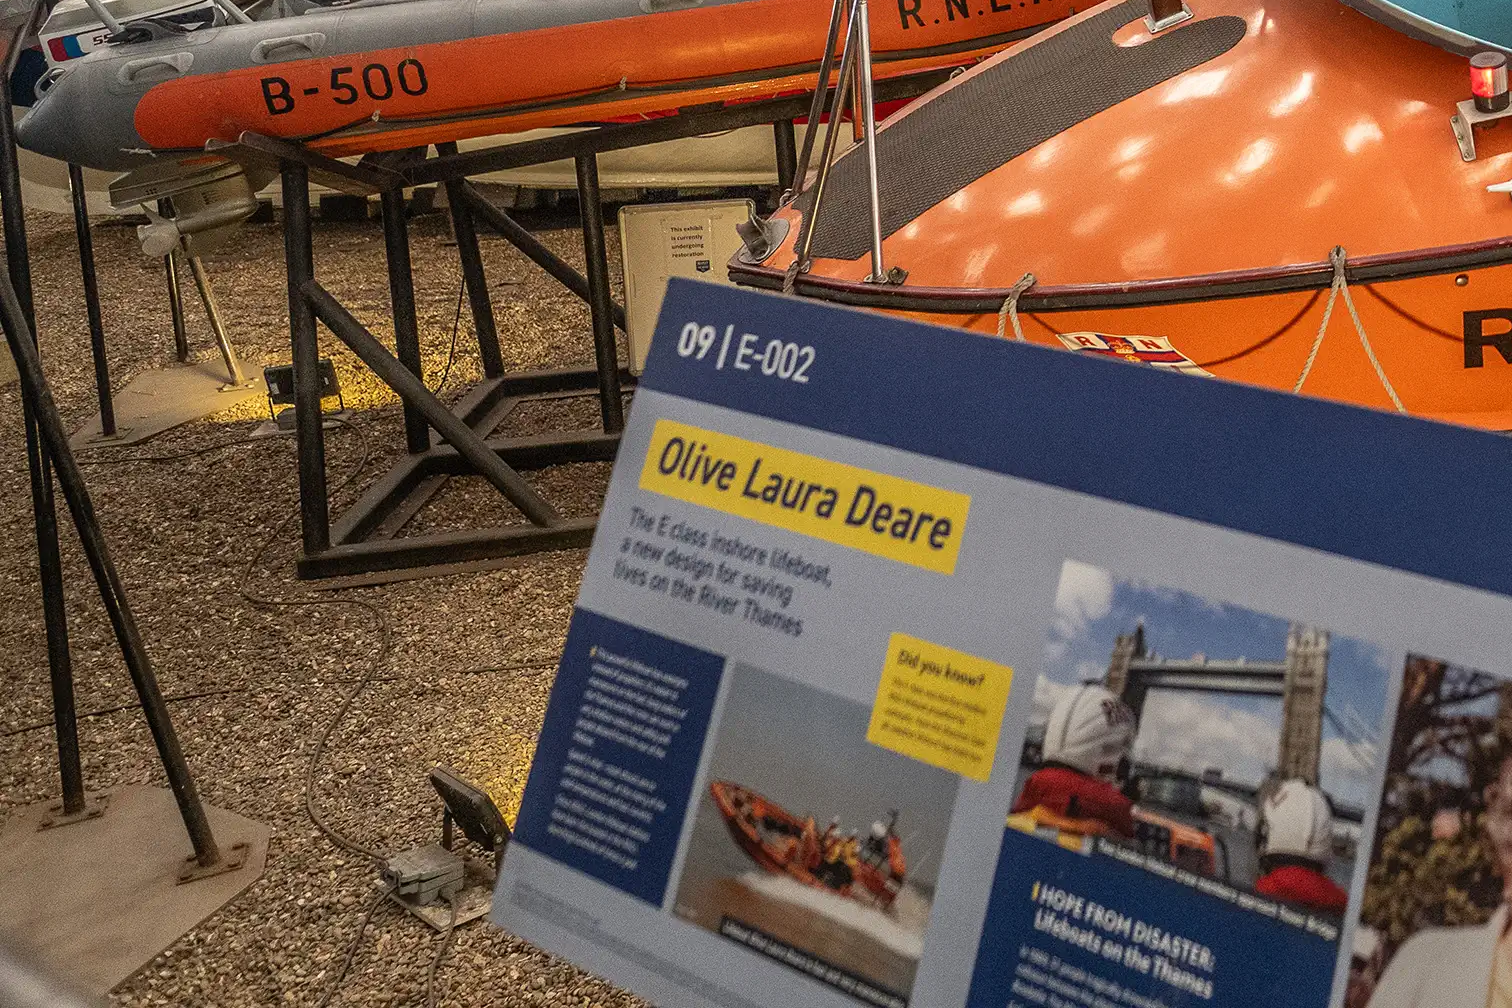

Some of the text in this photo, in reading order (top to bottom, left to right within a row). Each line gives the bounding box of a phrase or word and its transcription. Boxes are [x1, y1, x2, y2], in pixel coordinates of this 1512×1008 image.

[260, 59, 429, 116] B-500
[676, 322, 816, 384] 09 E-002
[657, 436, 952, 550] Olive Laura Deare
[630, 505, 656, 532] The
[657, 515, 671, 536] E
[670, 522, 709, 548] class
[710, 529, 768, 566] inshore
[613, 558, 803, 637] lives on the River Thames
[620, 537, 794, 608] a new design for saving
[897, 650, 985, 686] Did you know?
[1039, 884, 1085, 920] HOPE
[1085, 900, 1133, 939] FROM
[1034, 908, 1102, 954] Lifeboats
[1102, 939, 1123, 963] on
[1124, 945, 1151, 974] the
[1153, 955, 1214, 1000] Thames
